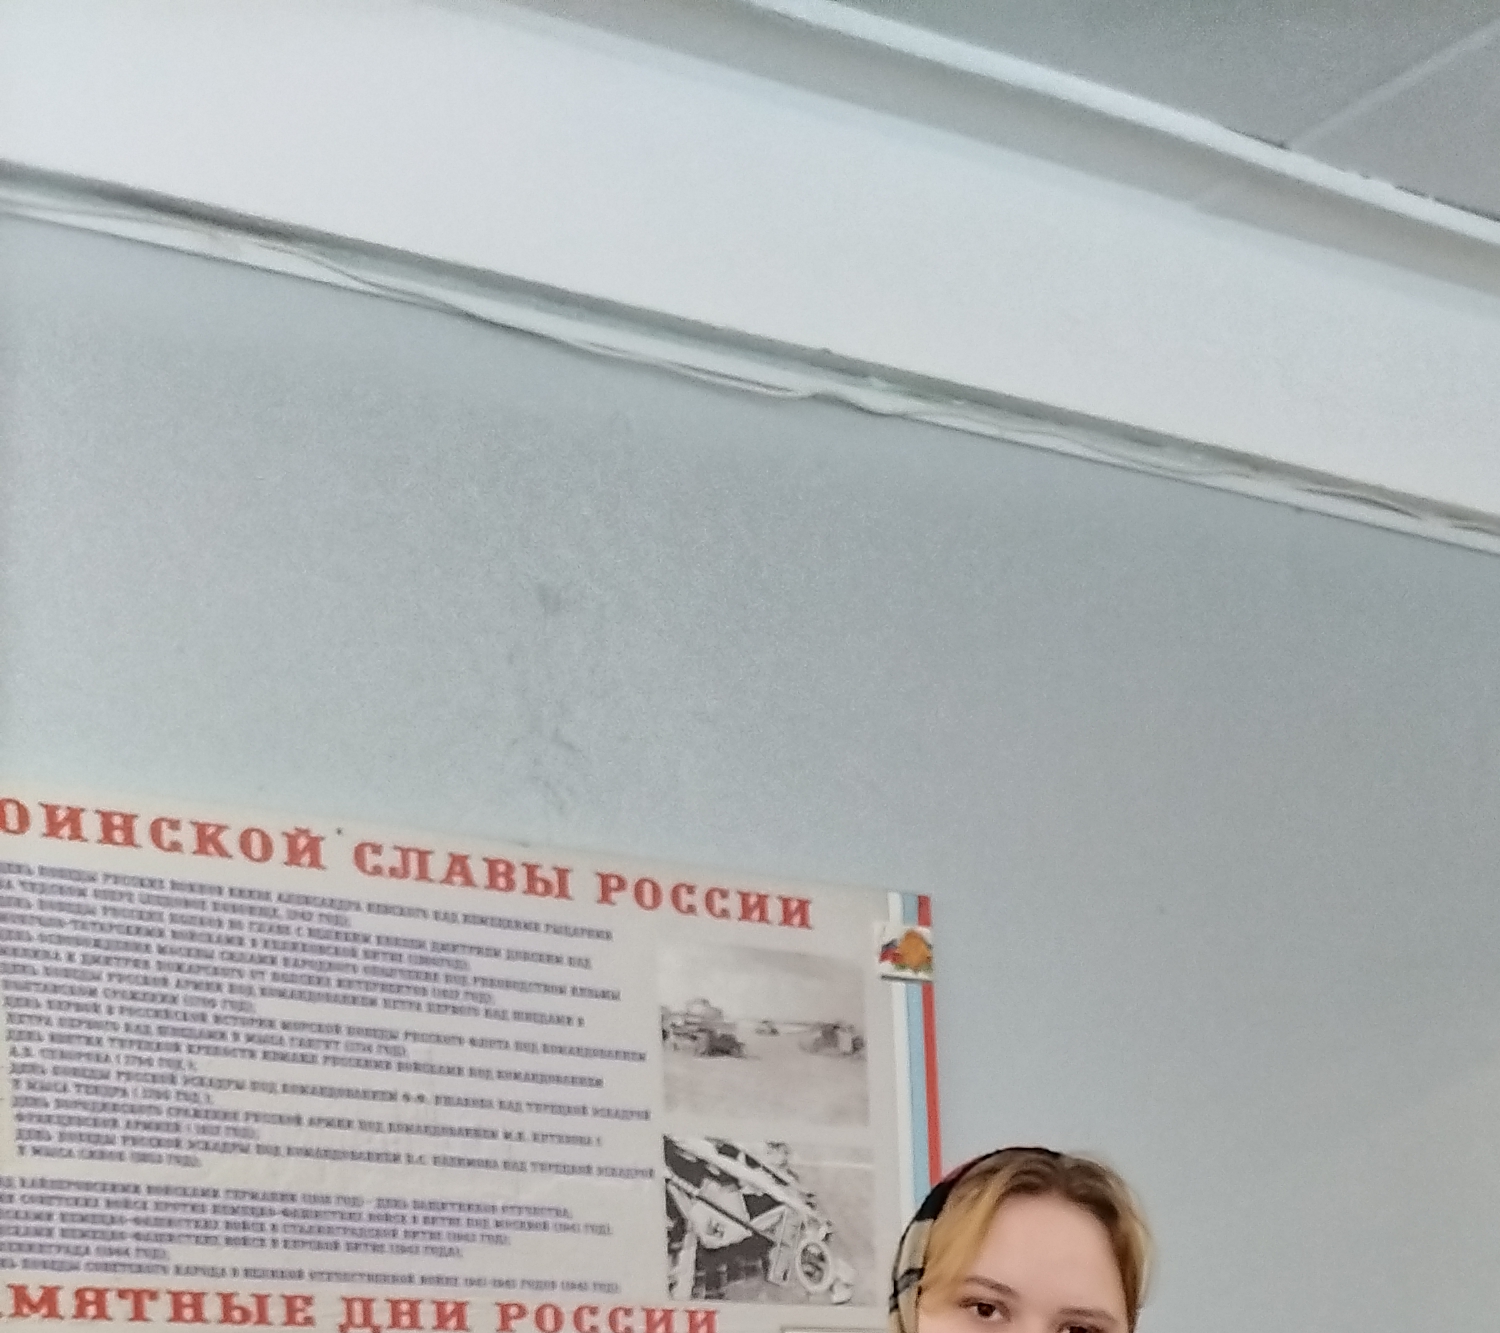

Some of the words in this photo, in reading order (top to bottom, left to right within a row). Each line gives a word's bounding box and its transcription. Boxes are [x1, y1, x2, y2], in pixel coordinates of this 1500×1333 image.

[0, 798, 326, 869] ОИНСКОЙ
[353, 841, 573, 900] СЛАВЫ
[595, 871, 813, 930] РОССИИ
